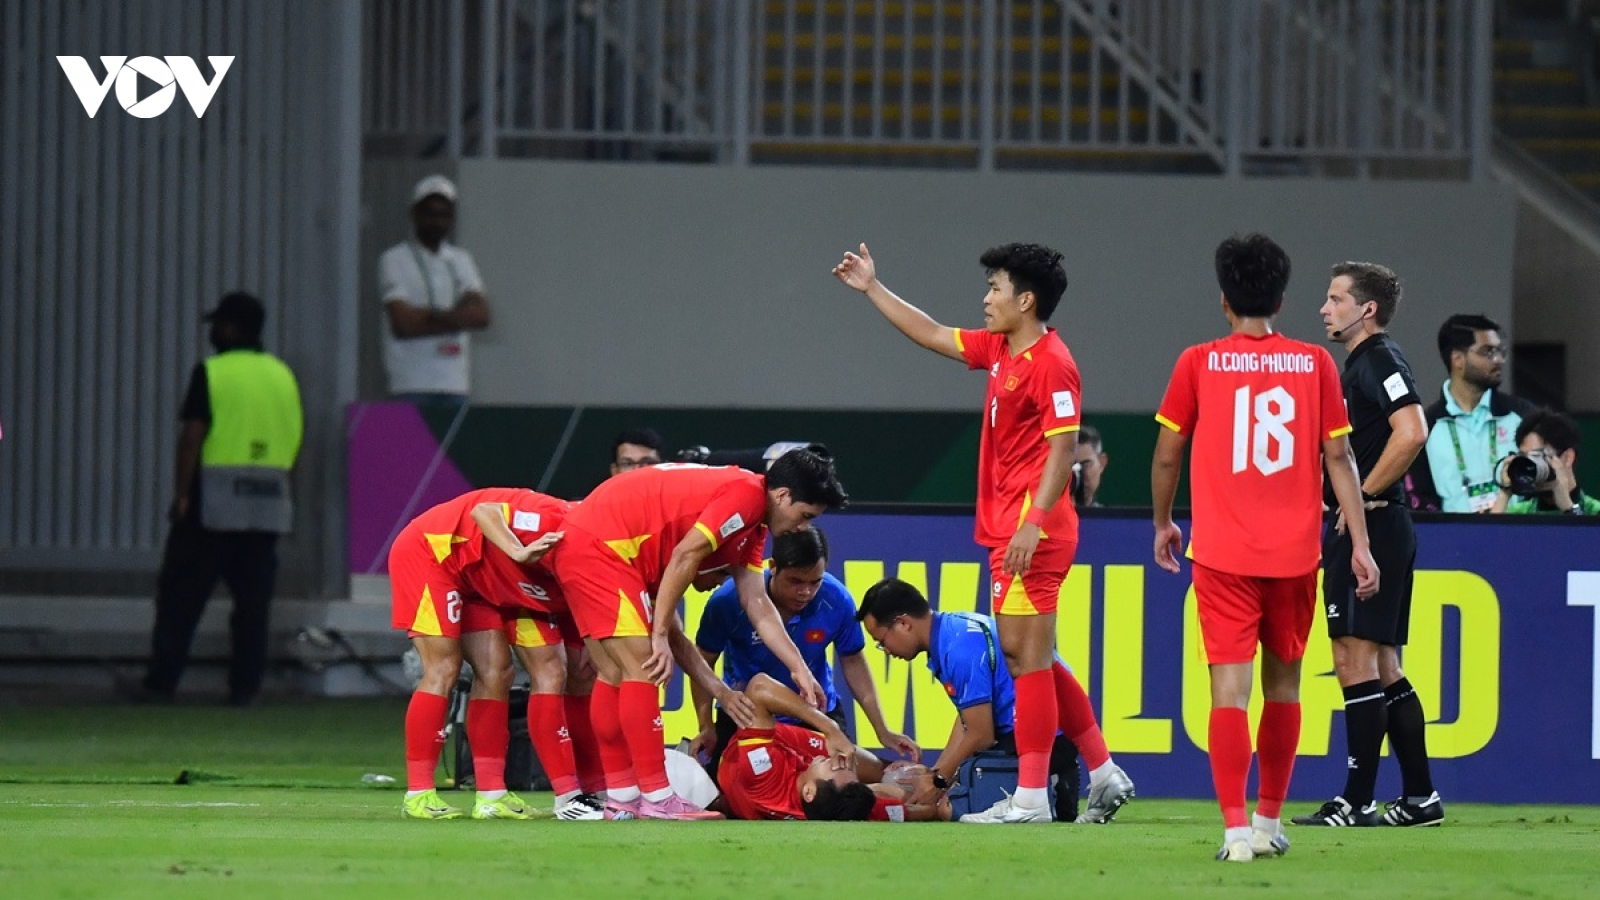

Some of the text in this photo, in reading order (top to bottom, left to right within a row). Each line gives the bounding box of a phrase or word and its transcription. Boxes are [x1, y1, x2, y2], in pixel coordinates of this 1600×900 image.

[1208, 351, 1315, 373] N.CONG PHUONG
[1232, 384, 1296, 476] 18
